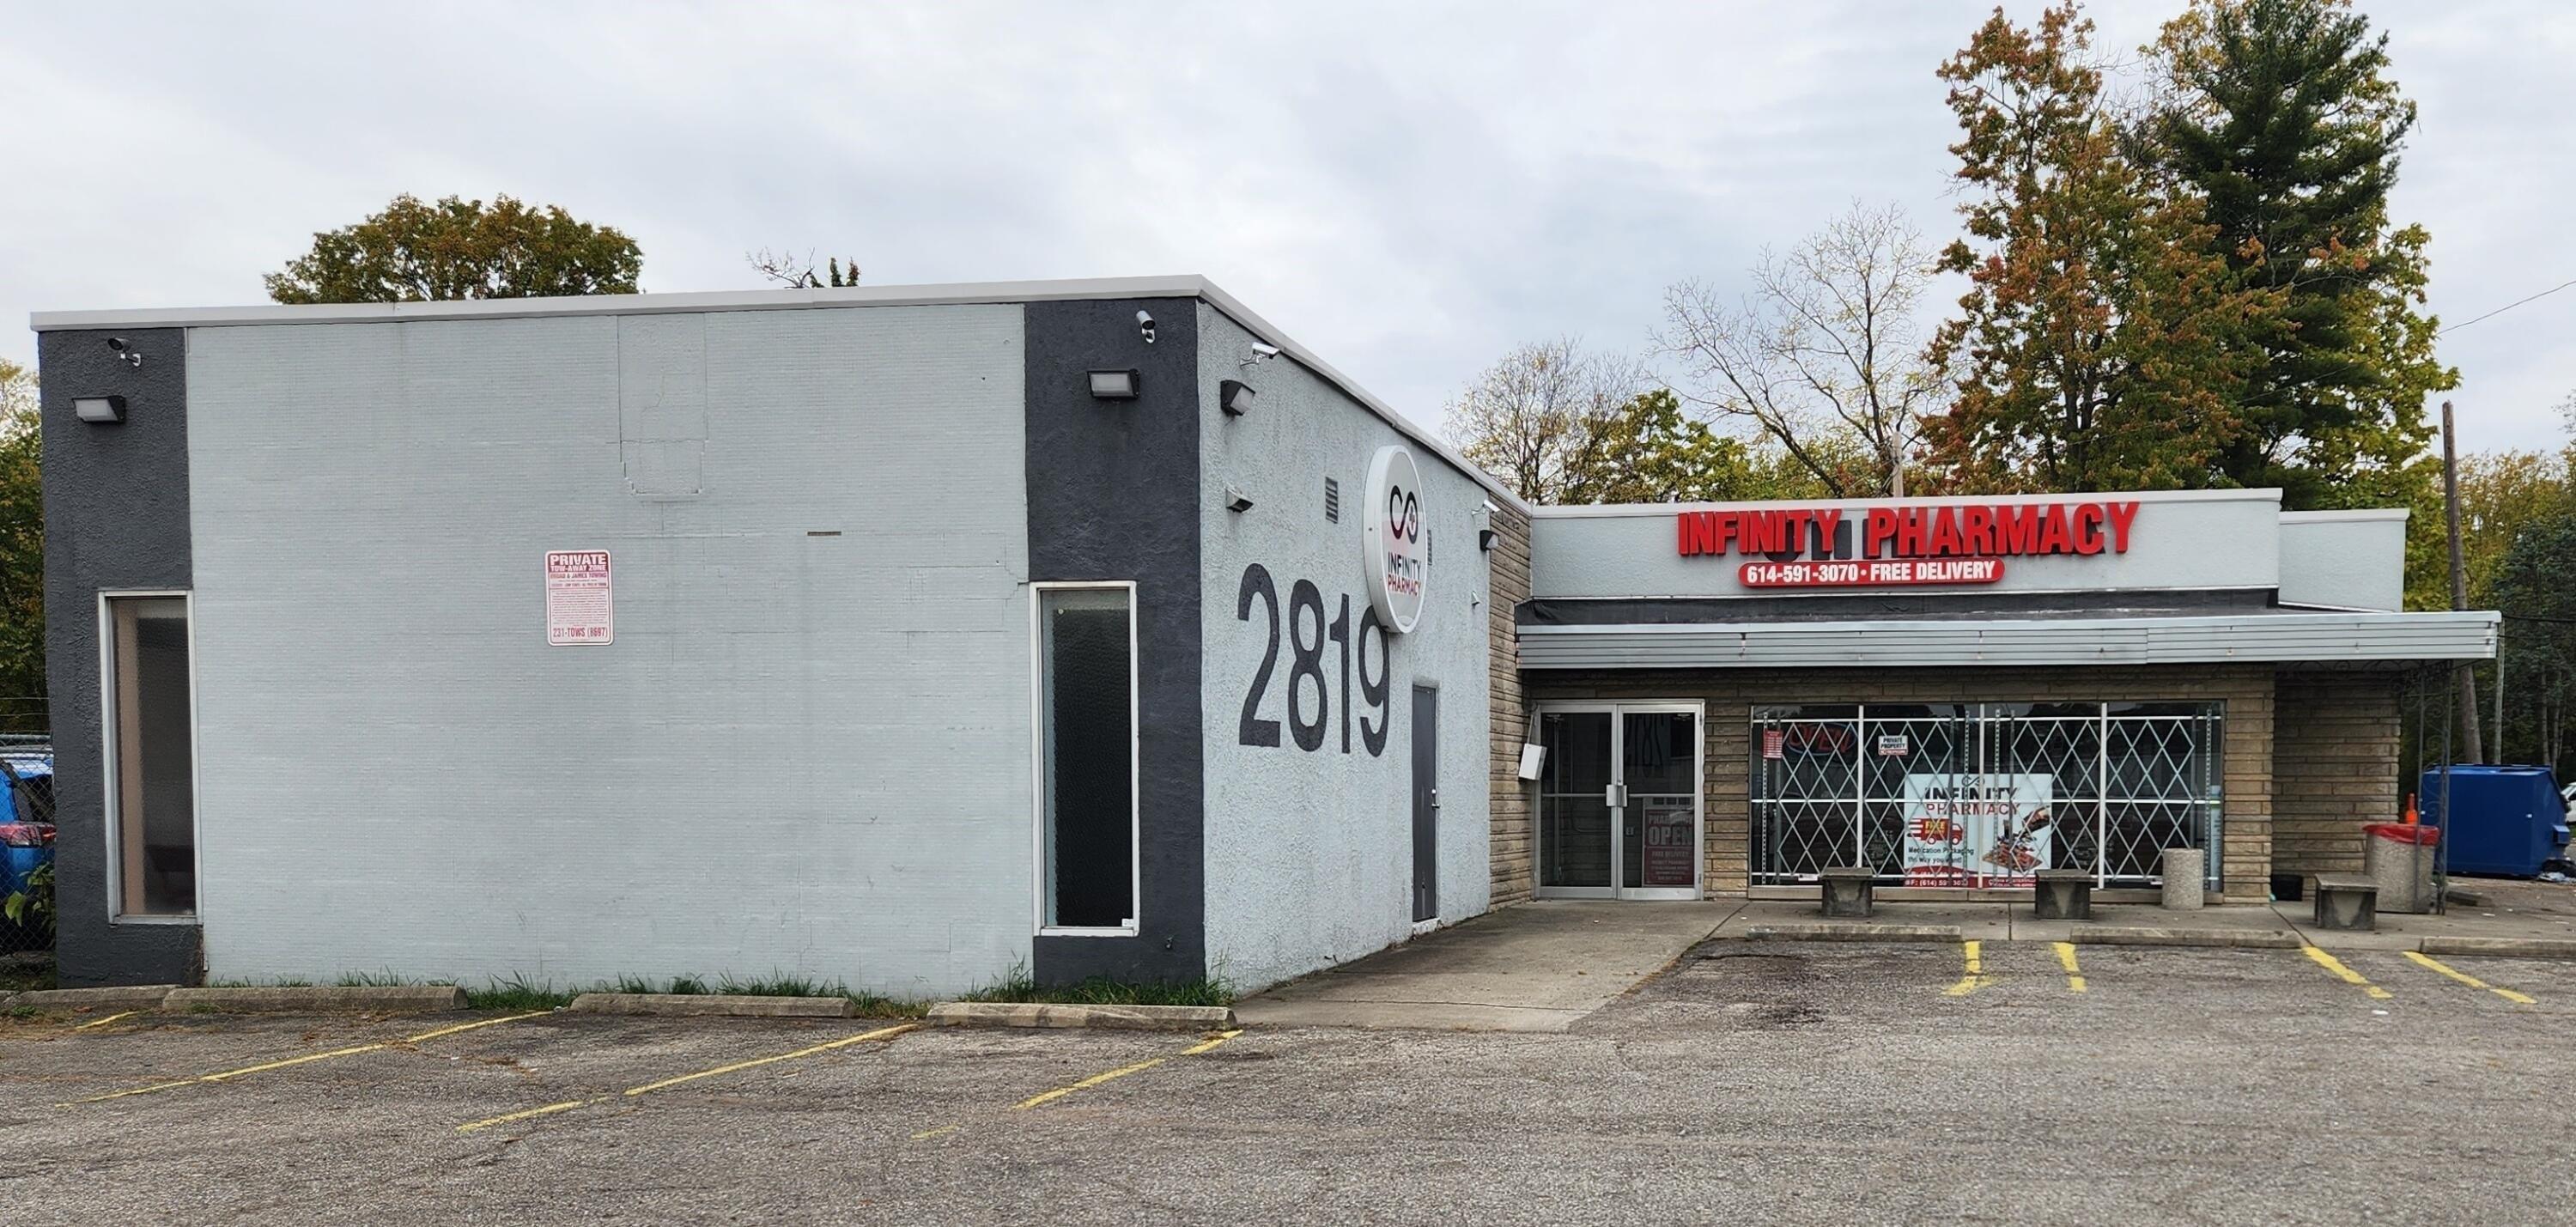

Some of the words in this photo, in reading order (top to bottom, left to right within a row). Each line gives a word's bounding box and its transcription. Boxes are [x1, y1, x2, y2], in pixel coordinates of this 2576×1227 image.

[1677, 508, 1843, 556] INFINITY
[1868, 501, 2140, 559] PHARMACY
[550, 555, 606, 565] PRIVATE
[1388, 550, 1421, 581] INFINITY
[1747, 563, 1858, 583] 614-591-3070
[1870, 562, 1911, 581] FREE
[1916, 560, 1996, 580] DELIVERY
[1388, 573, 1422, 598] PHARMACY
[553, 628, 586, 638] 231-TOWS
[1237, 562, 1390, 757] 2819
[1789, 724, 1851, 753] OPEN
[1925, 787, 2018, 799] INFINITY
[1648, 826, 1693, 846] OPEN
[1942, 847, 1974, 855] Pakagng
[1920, 878, 1937, 887] (614)
